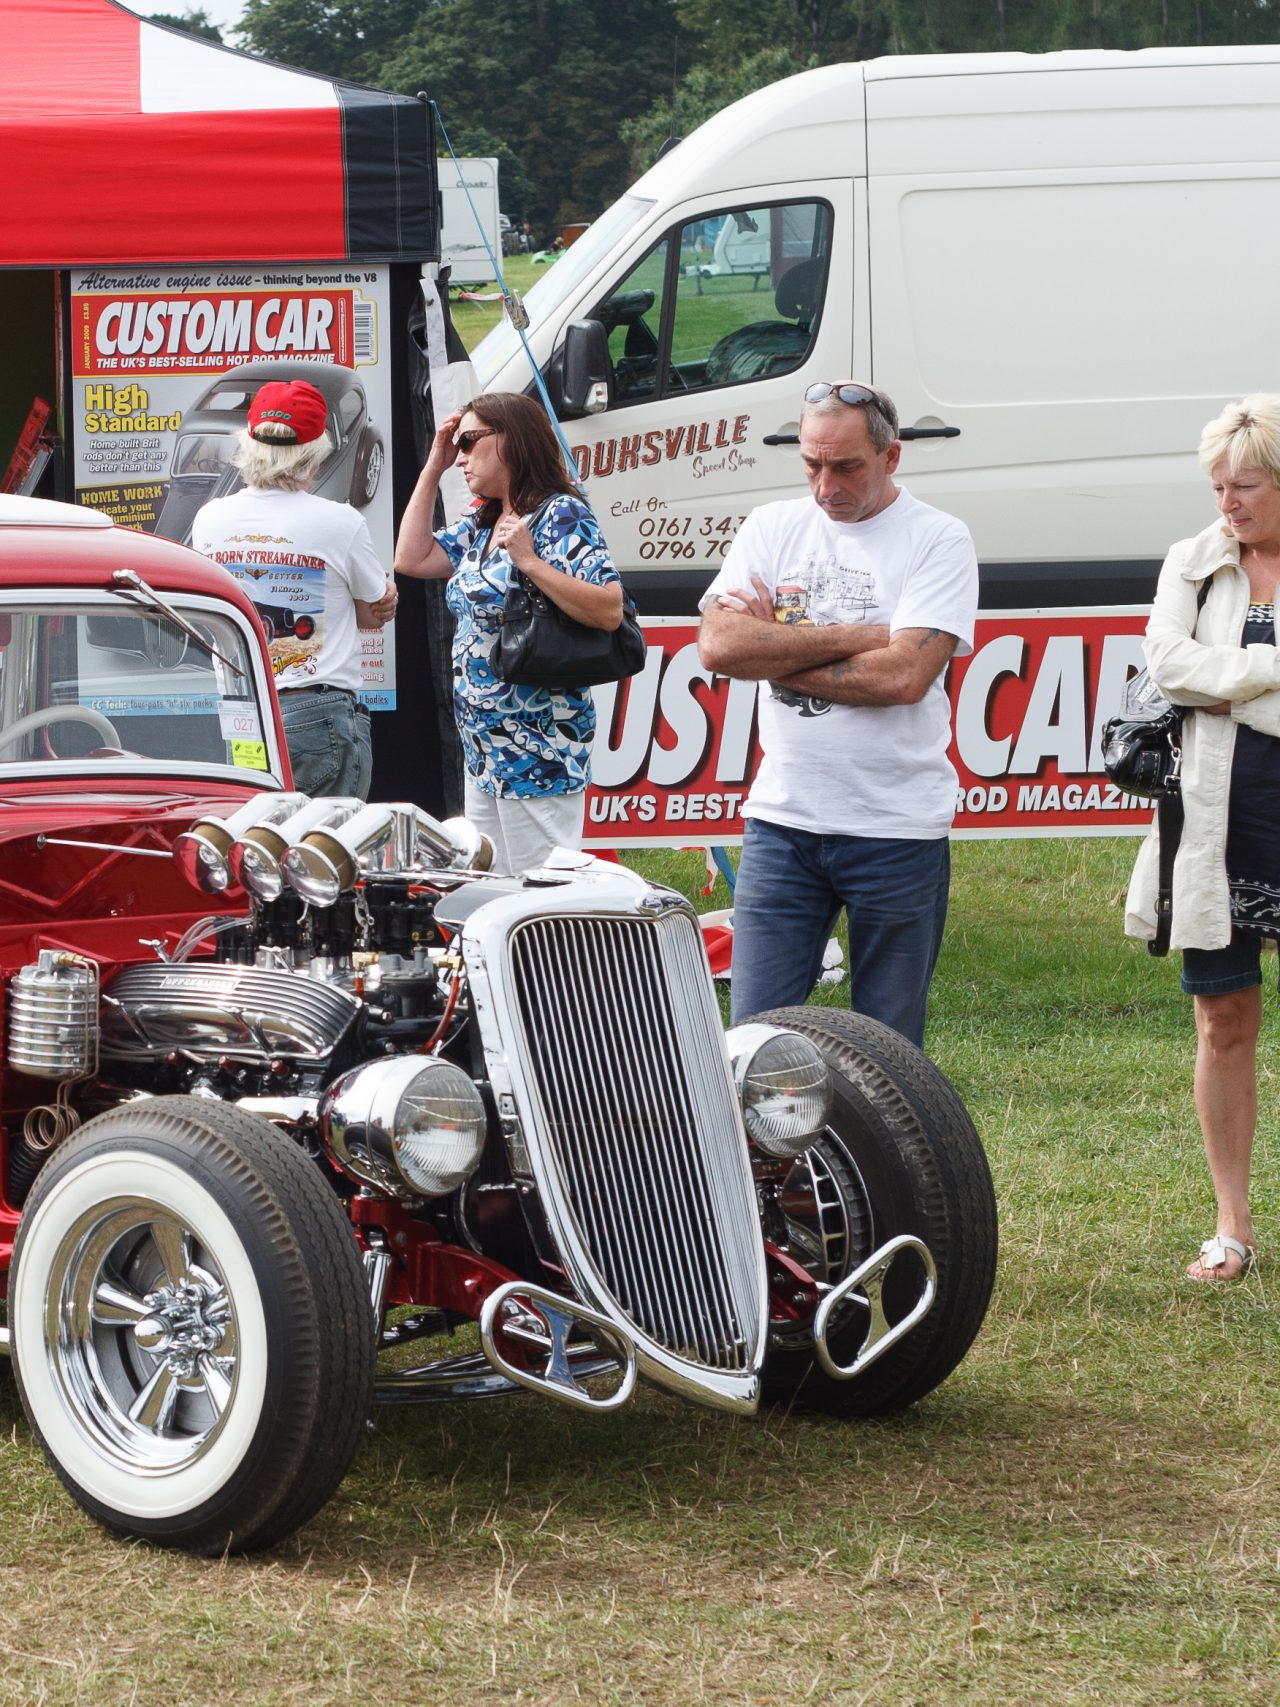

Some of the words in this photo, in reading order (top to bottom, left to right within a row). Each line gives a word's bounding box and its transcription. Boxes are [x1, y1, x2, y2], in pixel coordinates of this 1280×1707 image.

[78, 272, 160, 290] Alternative
[166, 273, 210, 293] engine
[217, 273, 252, 286] issue
[263, 274, 303, 286] thinking
[305, 273, 342, 285] beyond
[345, 273, 361, 282] the
[364, 272, 377, 283] V8
[97, 358, 118, 368] THE
[121, 357, 146, 368] UK'S
[149, 356, 223, 367] BEST-SELLING
[227, 355, 249, 366] HOT
[85, 384, 148, 416] High
[85, 411, 181, 432] Standard
[90, 440, 116, 449] Home
[119, 439, 140, 449] built
[142, 439, 159, 448] Brit
[83, 452, 103, 461] rods
[106, 451, 129, 460] don't
[132, 452, 147, 462] get
[150, 451, 166, 461] any
[692, 455, 726, 479] Speed
[728, 449, 758, 473] Shop
[89, 463, 118, 472] better
[120, 462, 141, 472] than
[143, 462, 161, 471] this
[81, 489, 119, 504] HOME
[124, 486, 163, 501] WORK
[130, 502, 152, 514] your
[610, 499, 640, 517] Call
[647, 497, 668, 513] On
[639, 517, 692, 537] 0161
[639, 541, 695, 560] 0796
[246, 551, 326, 571] STREAMLINER
[92, 701, 103, 710] CC
[180, 700, 190, 708] six
[193, 699, 213, 709] packs
[365, 694, 388, 704] bodies
[233, 717, 254, 731] 027
[1016, 784, 1158, 811] MAGAZIN
[589, 794, 656, 823] UK'S
